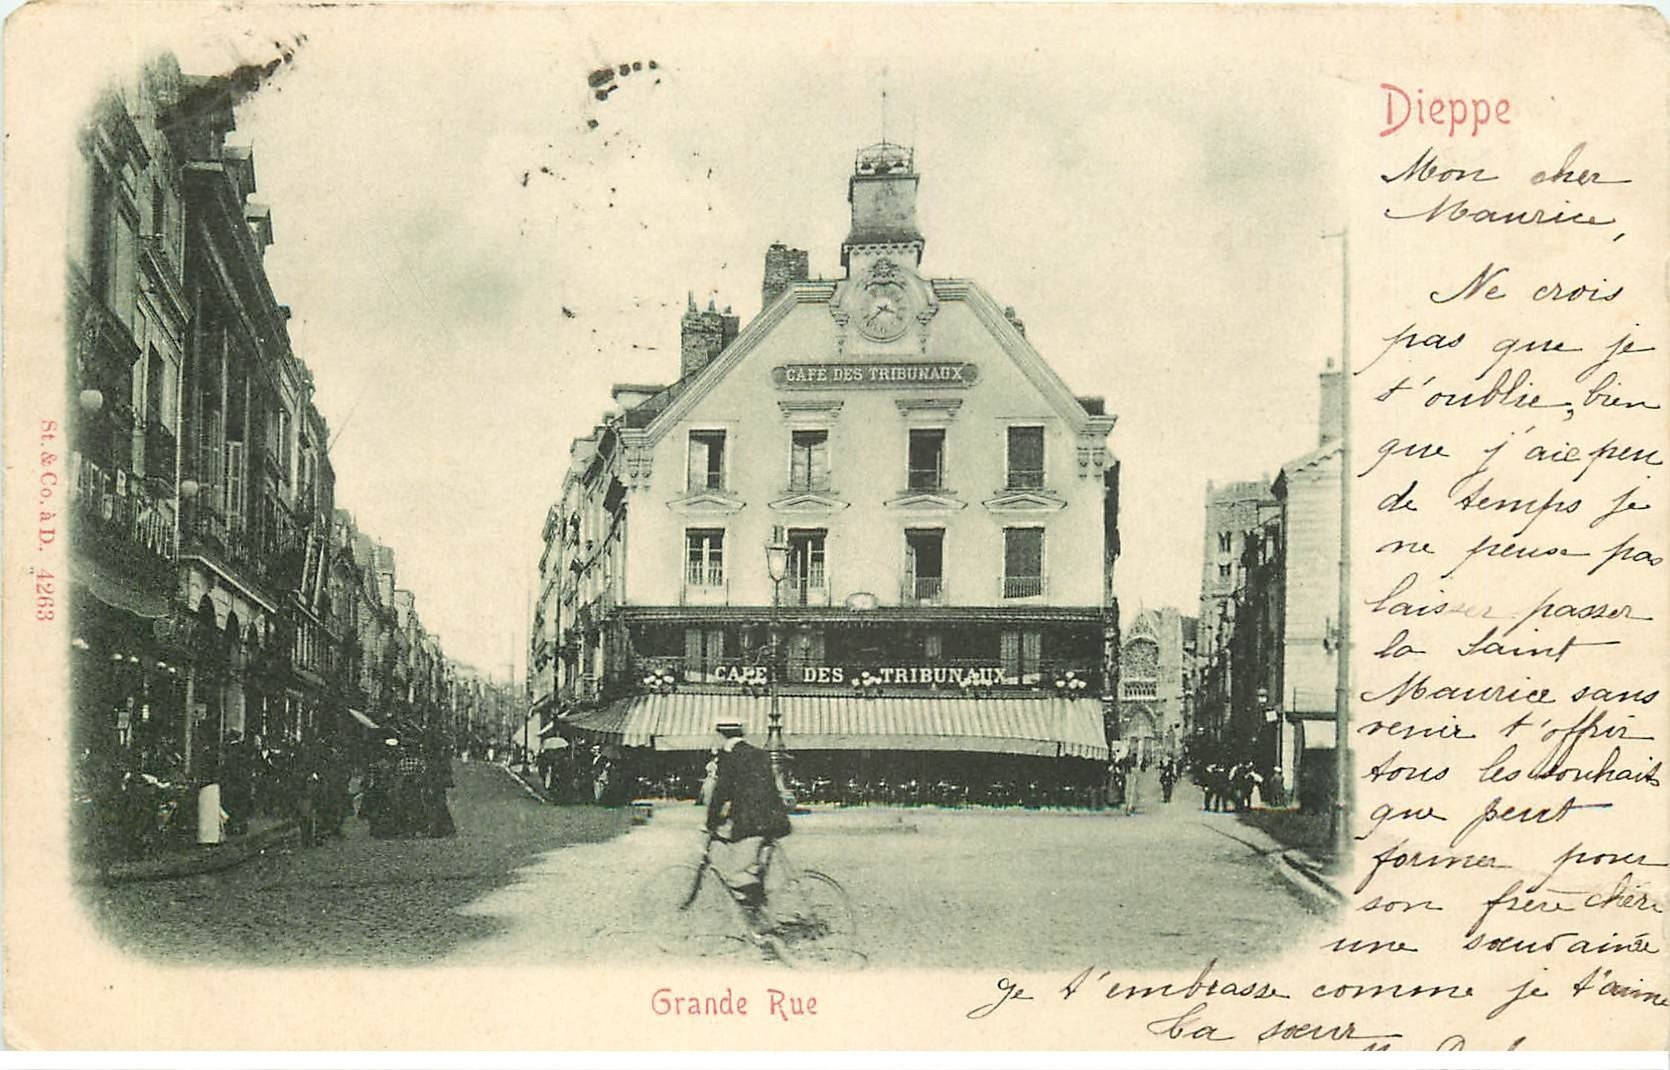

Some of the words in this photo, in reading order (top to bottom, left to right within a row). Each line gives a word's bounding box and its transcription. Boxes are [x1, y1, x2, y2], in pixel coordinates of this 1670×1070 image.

[1381, 146, 1499, 182] Mon
[1530, 142, 1632, 185] cher
[1430, 262, 1509, 303] Ne
[1532, 278, 1624, 301] crois
[833, 367, 863, 381] DES
[869, 366, 963, 380] TRIBUNAUX
[1353, 323, 1466, 375] pas
[1475, 338, 1583, 380] que
[1575, 323, 1656, 383] je
[1583, 371, 1661, 409] bien
[1357, 438, 1450, 477] que
[1572, 438, 1664, 482] peu
[1377, 480, 1417, 511] de
[1453, 477, 1582, 537] temps
[1589, 475, 1651, 528] je
[1375, 540, 1435, 554] ne
[1587, 533, 1663, 575] pas
[1502, 587, 1653, 637] passer
[1374, 629, 1426, 658] la
[1457, 626, 1621, 662] Saint
[803, 667, 843, 682] DES
[880, 667, 1006, 684] TRIBUNAUX
[1360, 671, 1556, 705] Maurice
[1571, 686, 1660, 704] sans
[1357, 715, 1476, 739] venir
[1362, 750, 1450, 782] tous
[1478, 743, 1522, 782] les
[1353, 804, 1447, 840] que
[1450, 796, 1613, 848] peut
[1526, 842, 1669, 893] pour
[1356, 896, 1442, 911] son
[1322, 936, 1418, 953] une
[1059, 958, 1290, 1000] t'embrasse
[1312, 983, 1473, 998] comme
[1486, 967, 1549, 1019] je
